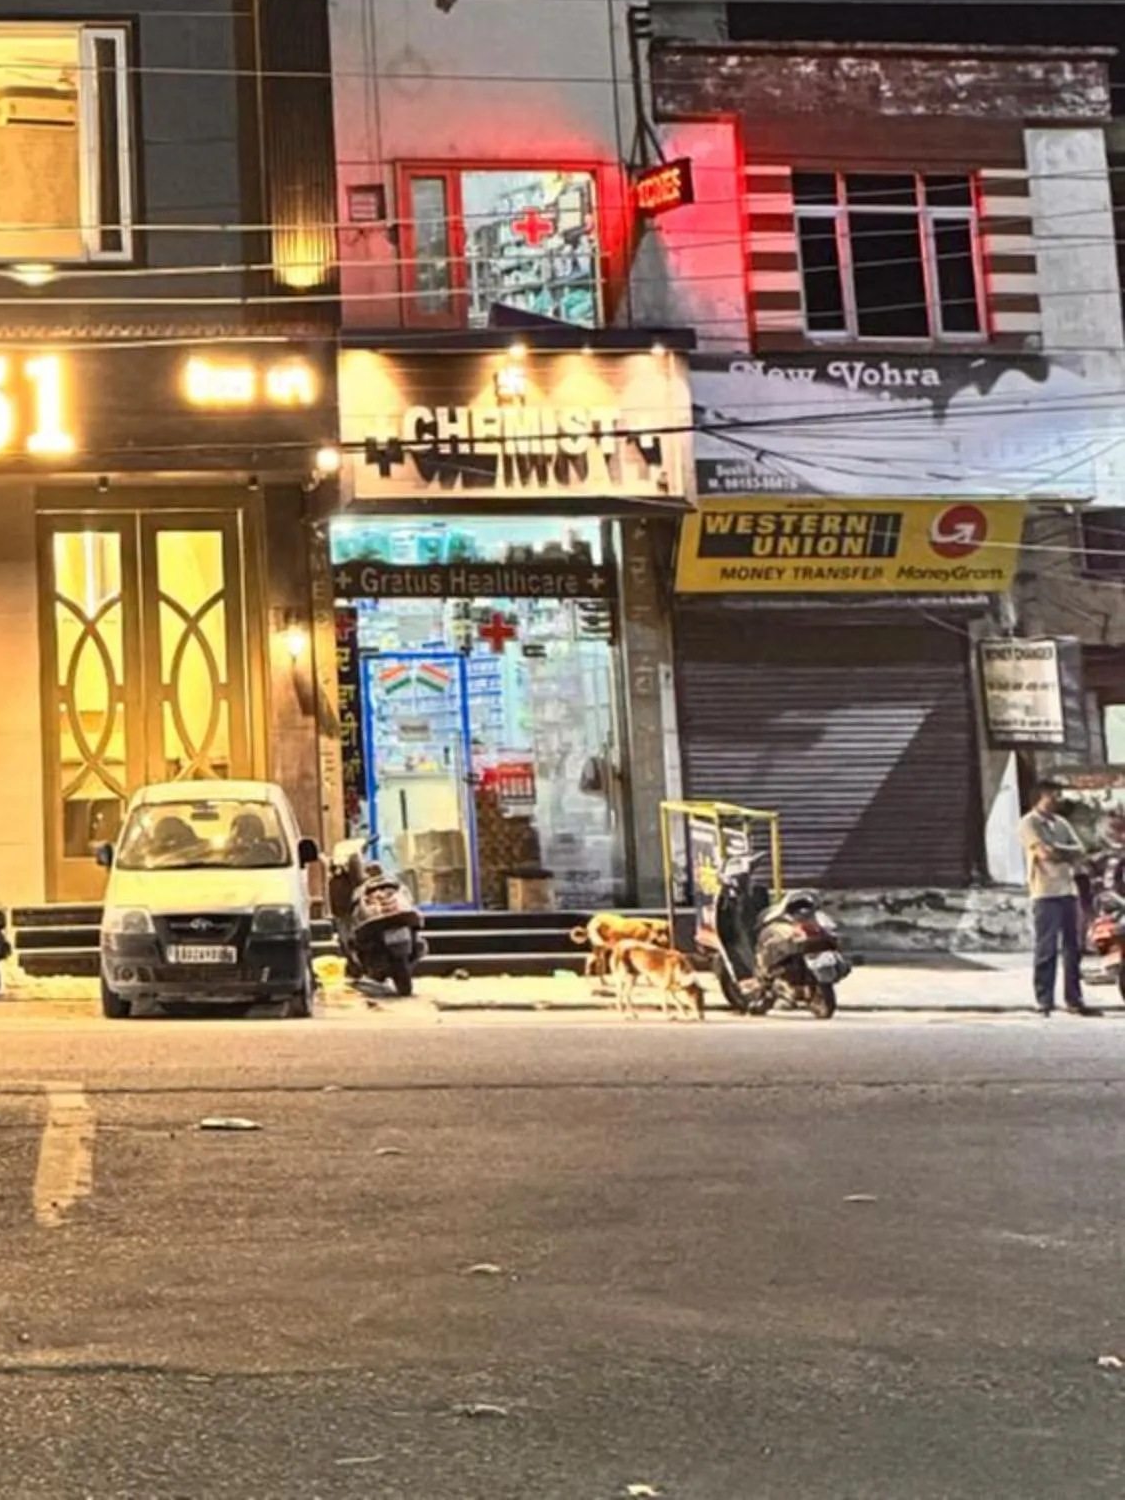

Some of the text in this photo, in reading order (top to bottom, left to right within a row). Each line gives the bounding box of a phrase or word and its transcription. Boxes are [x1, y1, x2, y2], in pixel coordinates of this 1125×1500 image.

[826, 361, 941, 391] Vohra
[403, 405, 624, 455] CHEMIST
[704, 514, 867, 535] WESTERN
[751, 537, 864, 556] UNION
[360, 567, 579, 594] Gratus Healthcare
[720, 566, 785, 581] MONEY
[896, 565, 1004, 584] MoneyGram
